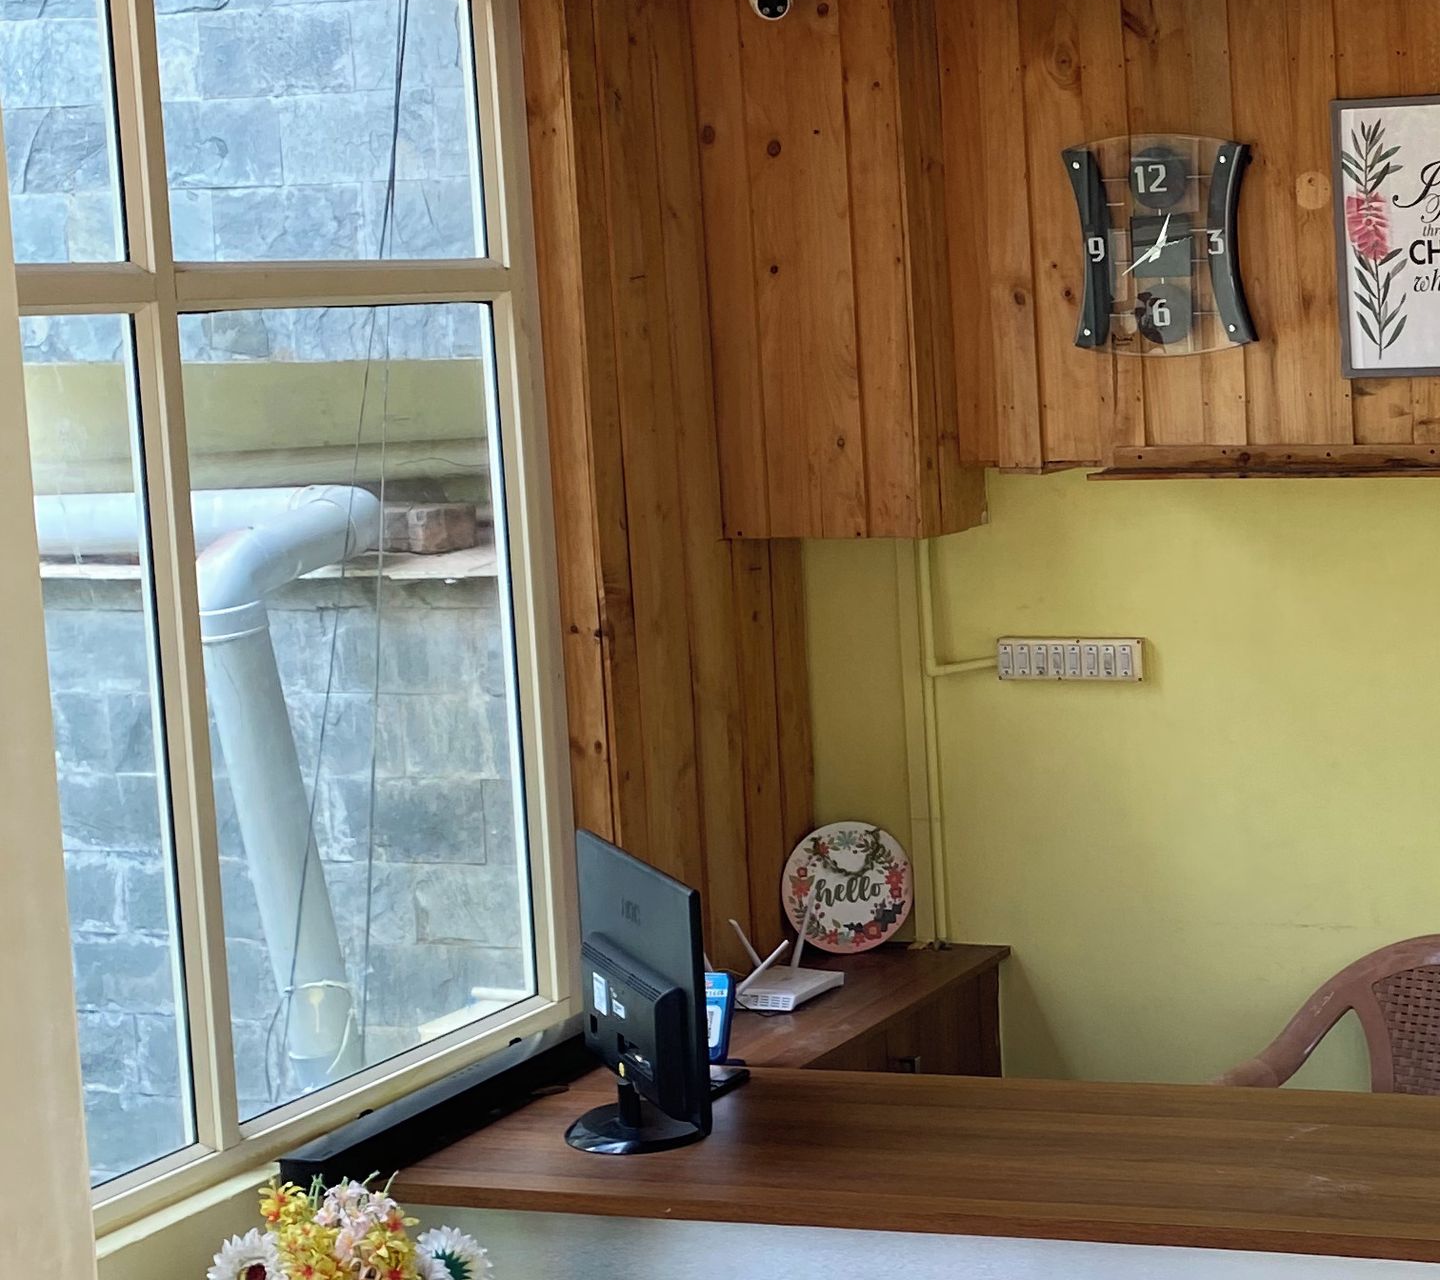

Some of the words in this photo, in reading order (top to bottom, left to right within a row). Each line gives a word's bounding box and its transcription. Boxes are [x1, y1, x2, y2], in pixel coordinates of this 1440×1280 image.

[1134, 164, 1168, 194] 12
[1088, 237, 1105, 262] 9
[1207, 229, 1225, 255] 3
[1152, 299, 1171, 327] 6
[815, 876, 885, 907] hello
